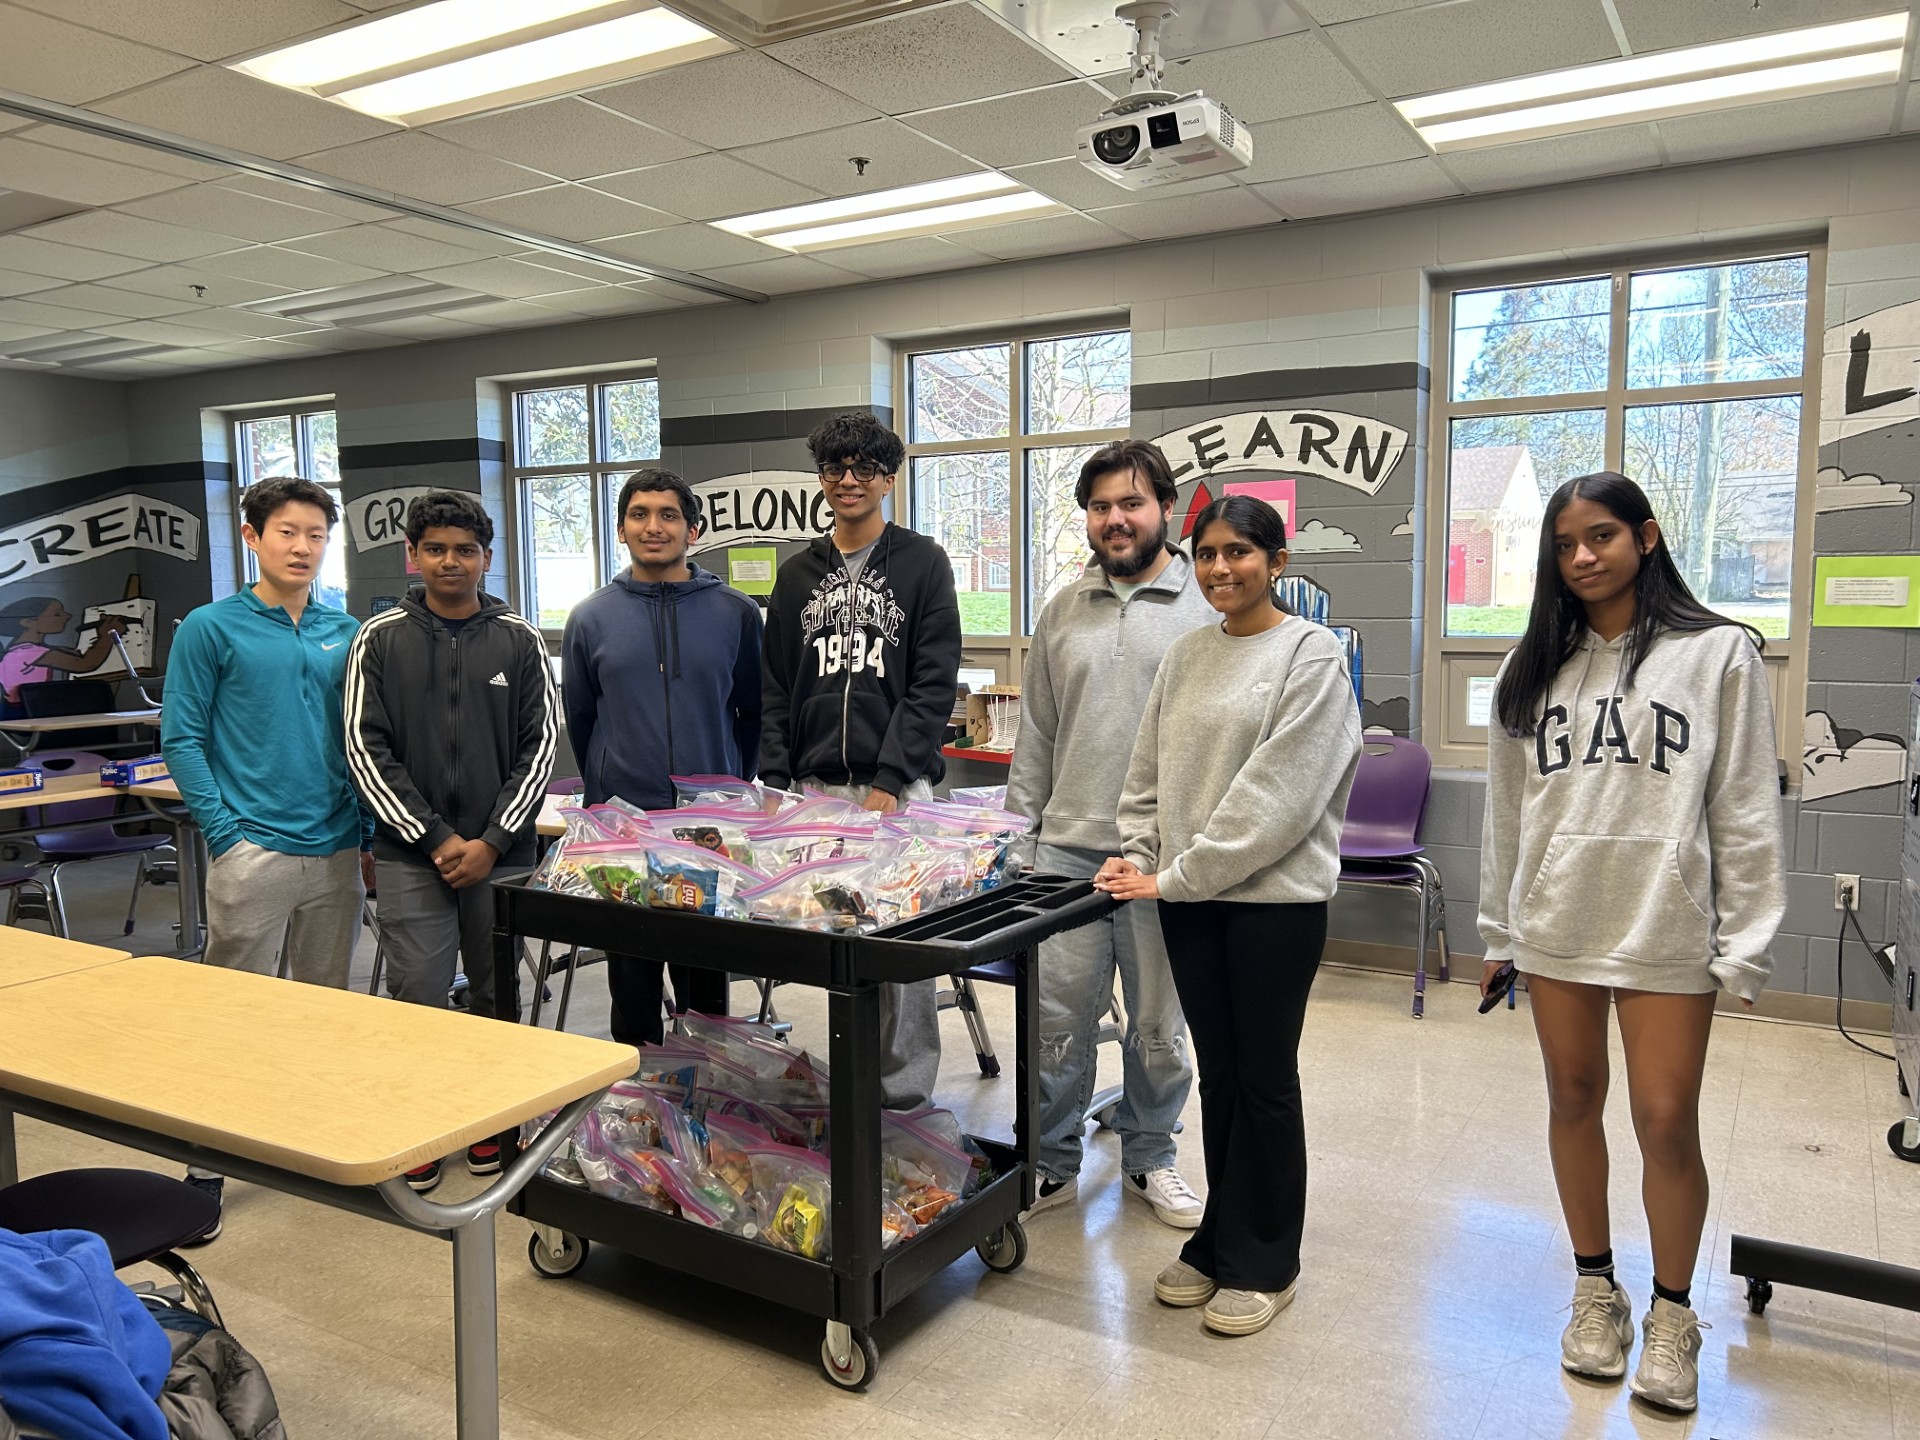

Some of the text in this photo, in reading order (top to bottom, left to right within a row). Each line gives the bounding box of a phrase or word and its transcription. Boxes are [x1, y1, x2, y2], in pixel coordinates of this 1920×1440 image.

[1845, 328, 1920, 415] L
[364, 497, 419, 541] GR
[813, 633, 885, 678] 1994
[1535, 696, 1691, 778] GAP
[681, 883, 697, 907] Lay
